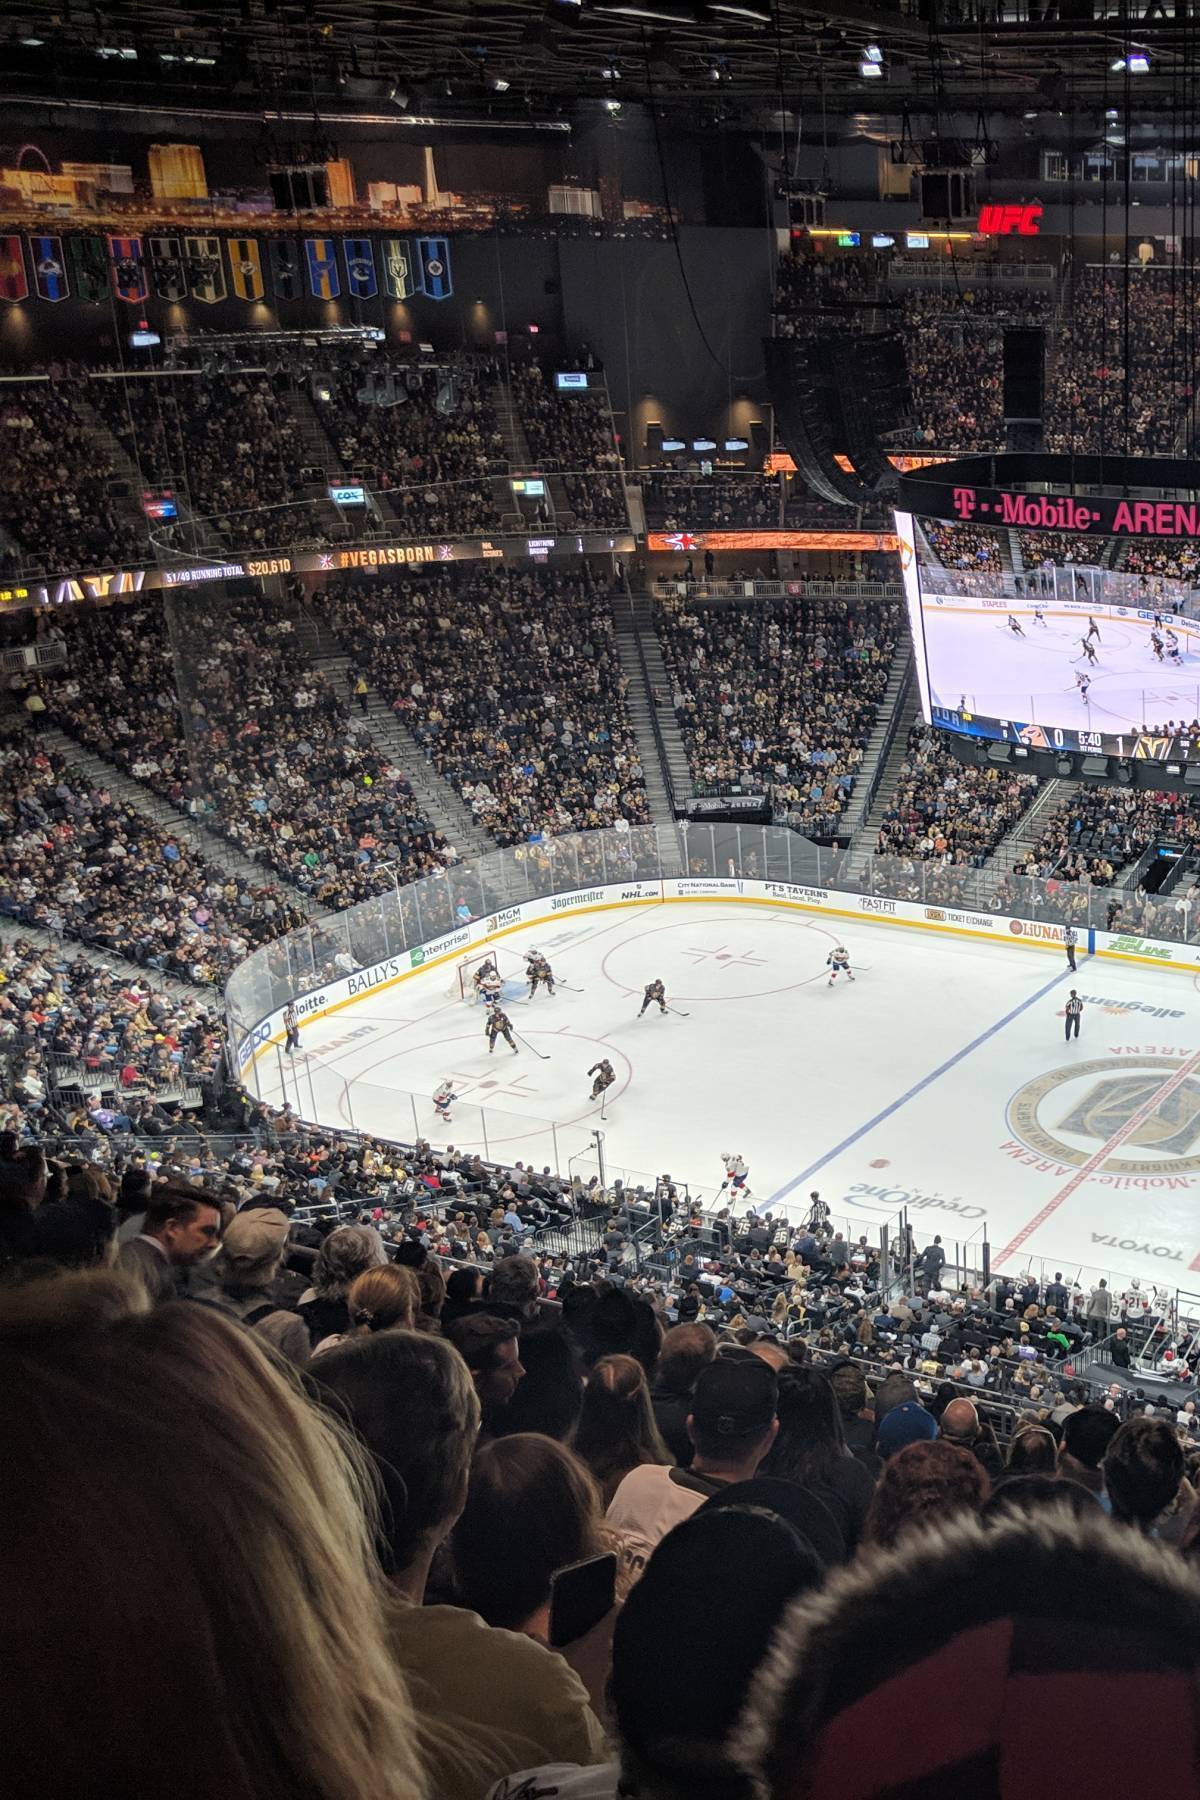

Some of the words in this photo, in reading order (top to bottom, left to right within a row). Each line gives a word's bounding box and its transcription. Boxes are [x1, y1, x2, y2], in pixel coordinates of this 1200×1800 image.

[978, 205, 1043, 234] UFC
[340, 546, 434, 567] #VEGASBORN
[166, 572, 191, 583] 51/49
[191, 568, 222, 580] RUNNING
[223, 565, 244, 576] TOTAL
[248, 559, 291, 576] $20,610
[1137, 610, 1173, 624] GECO
[1054, 729, 1064, 747] 0
[1078, 731, 1101, 747] 5:40
[1116, 736, 1124, 761] 1
[787, 886, 828, 898] TAVERNS
[498, 908, 520, 922] MGM
[948, 913, 965, 922] TICKET
[966, 915, 993, 927] EXCHANGE
[412, 932, 470, 963] enterprise
[347, 960, 399, 995] BALLY'S
[1109, 1046, 1193, 1057] ARENA
[999, 1140, 1073, 1177] ARENA
[1120, 1160, 1192, 1172] KNIGHTS
[773, 1232, 788, 1244] 26
[1090, 1231, 1185, 1262] TOYOTA
[1128, 1296, 1140, 1308] 21
